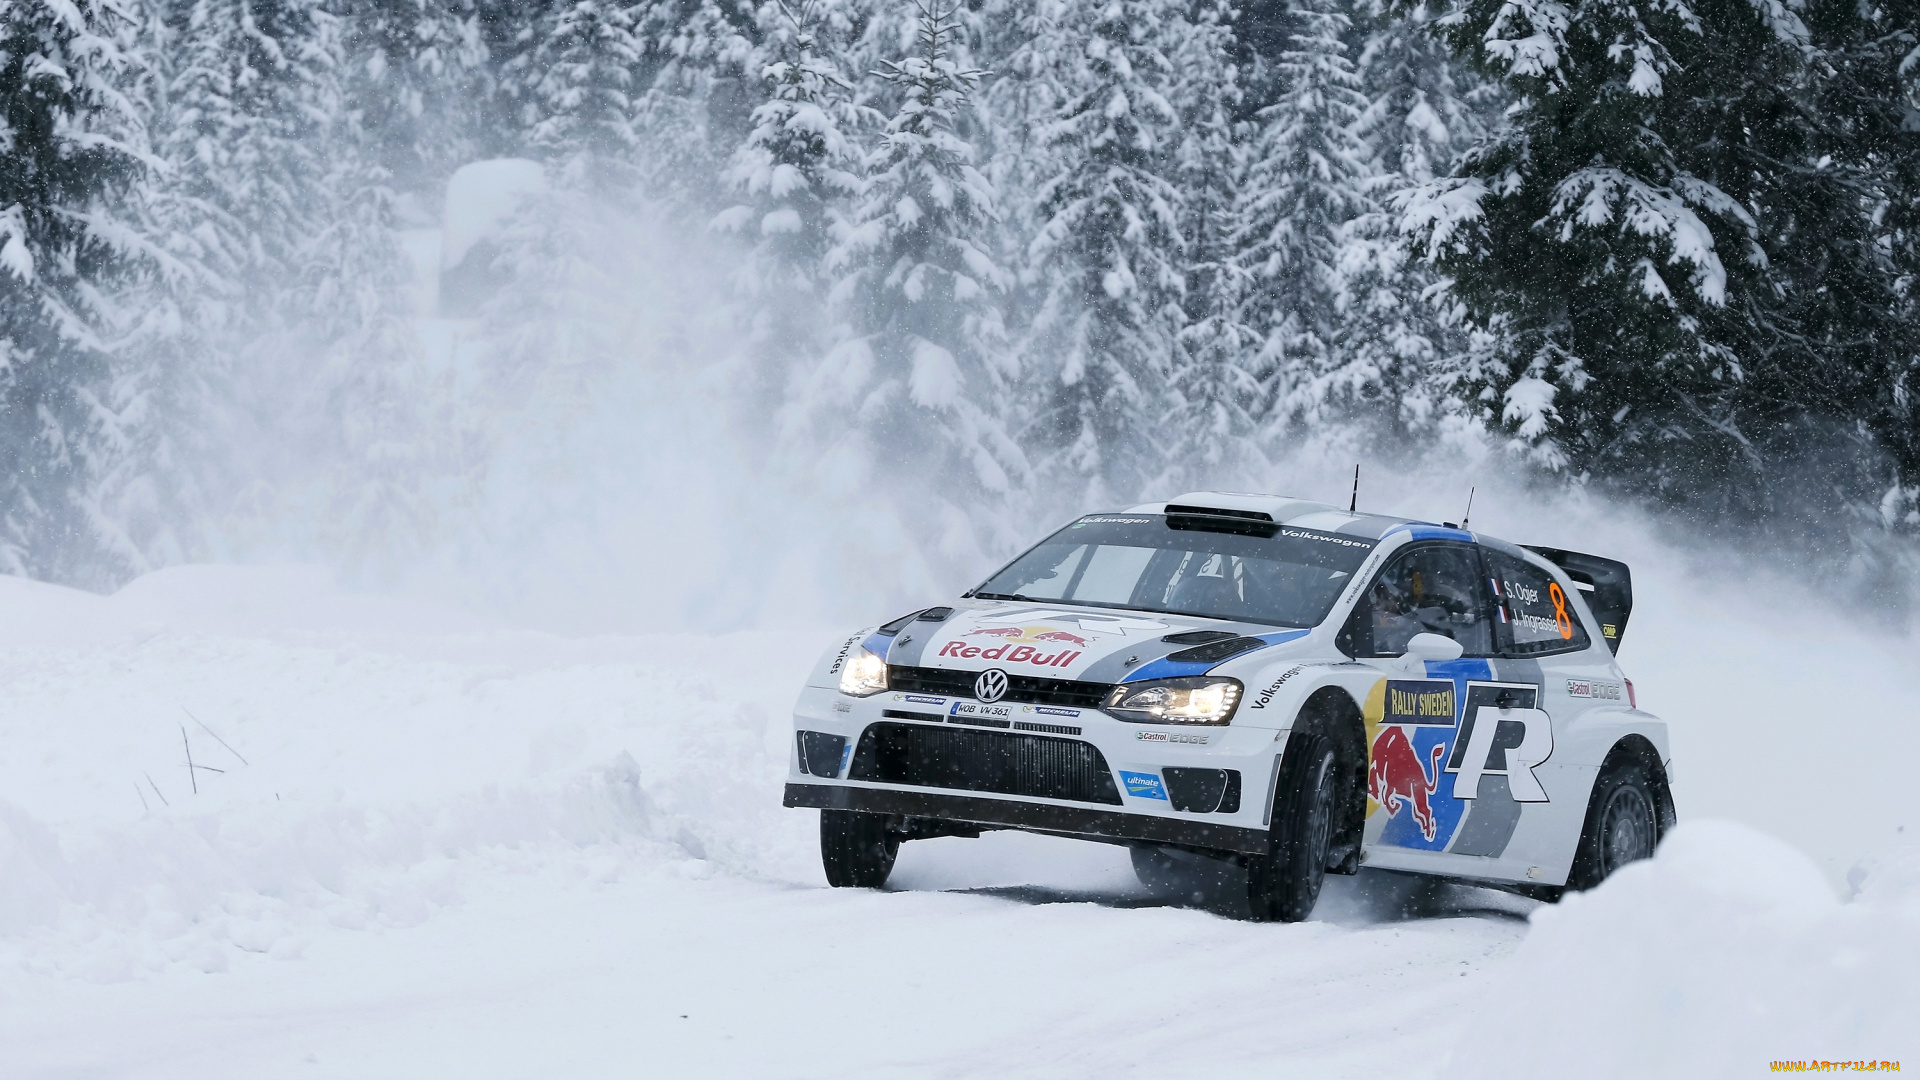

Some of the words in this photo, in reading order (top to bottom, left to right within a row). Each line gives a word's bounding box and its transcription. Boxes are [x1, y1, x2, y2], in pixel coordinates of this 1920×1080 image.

[1281, 529, 1371, 549] Volkswagen
[1504, 581, 1516, 599] S.
[1515, 583, 1538, 605] Ogier
[1521, 609, 1560, 633] Ingrassia
[1549, 582, 1572, 640] 8
[830, 636, 861, 675] Services
[939, 641, 1012, 661] Red
[1005, 646, 1082, 668] Bull
[908, 695, 946, 704] MICHELIN
[958, 704, 976, 713] WOB
[1391, 688, 1417, 715] RALLY
[1419, 690, 1453, 717] SWEDEN
[1039, 707, 1080, 717] MICHELIN
[1143, 732, 1167, 741] Castrol
[1169, 733, 1209, 745] EDGE
[1444, 681, 1554, 803] R
[1127, 776, 1159, 787] ultimate
